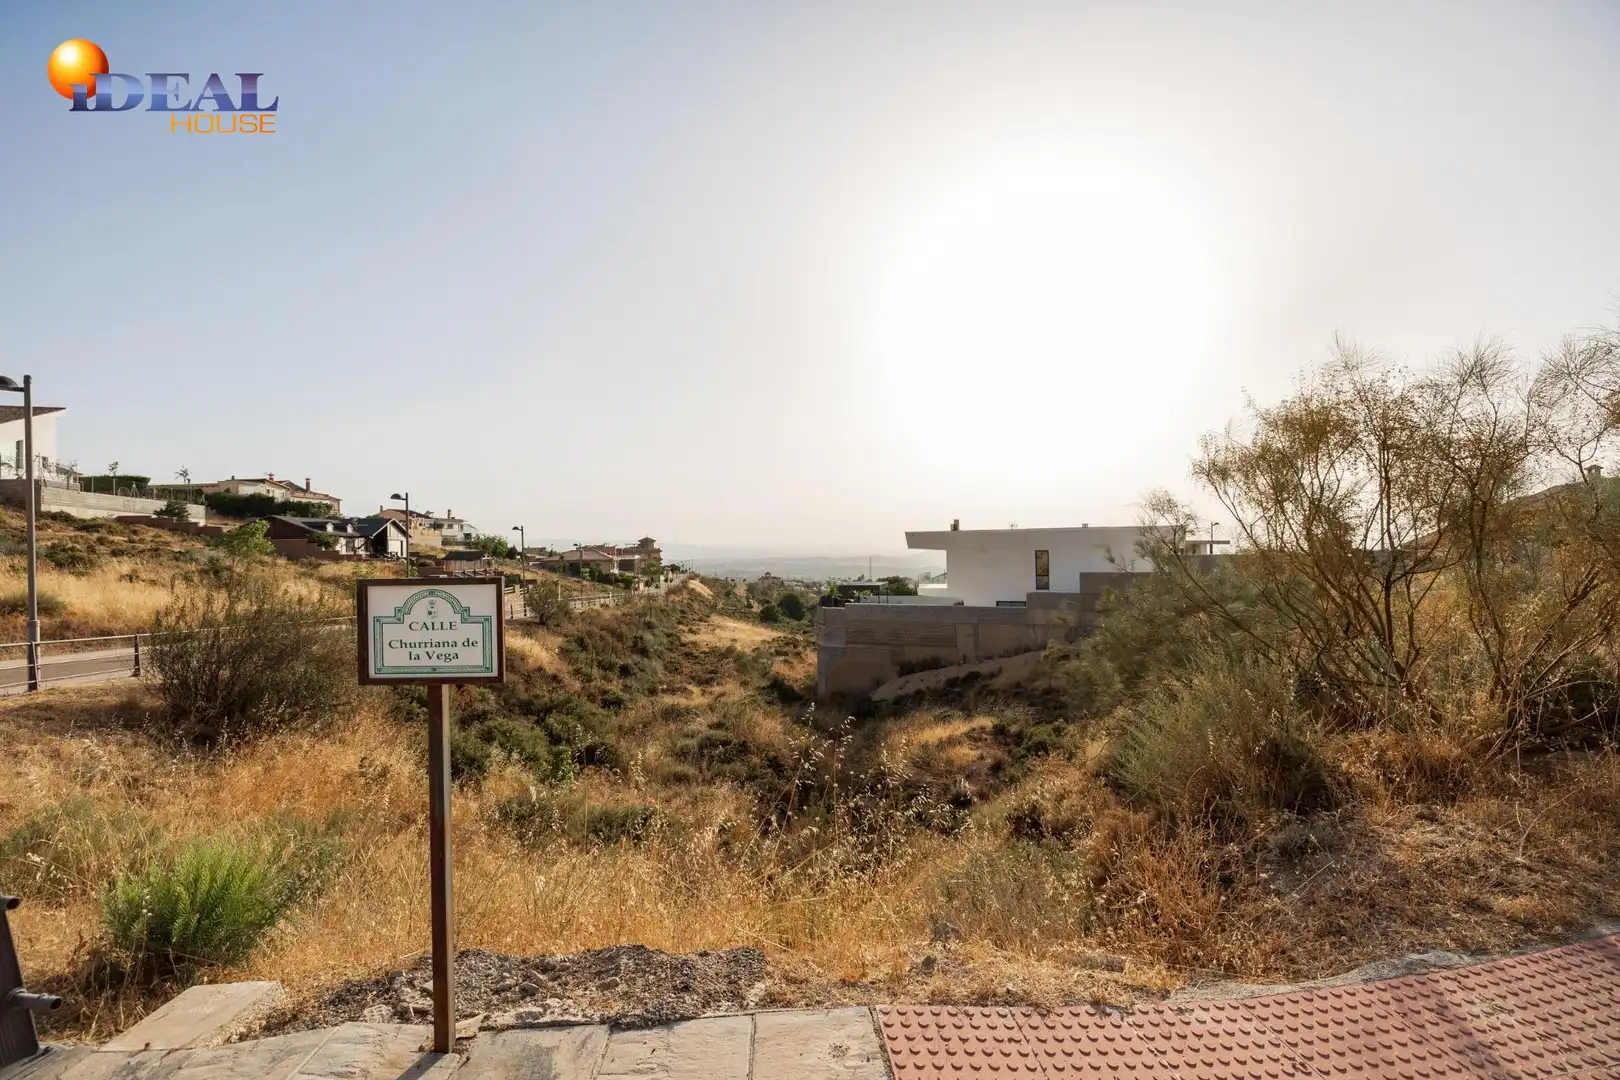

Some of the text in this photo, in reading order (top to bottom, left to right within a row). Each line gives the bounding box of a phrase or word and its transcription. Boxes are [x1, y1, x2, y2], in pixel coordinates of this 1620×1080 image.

[408, 621, 458, 631] CALLE
[388, 637, 479, 649] Churriana de
[408, 650, 460, 663] la Vega
